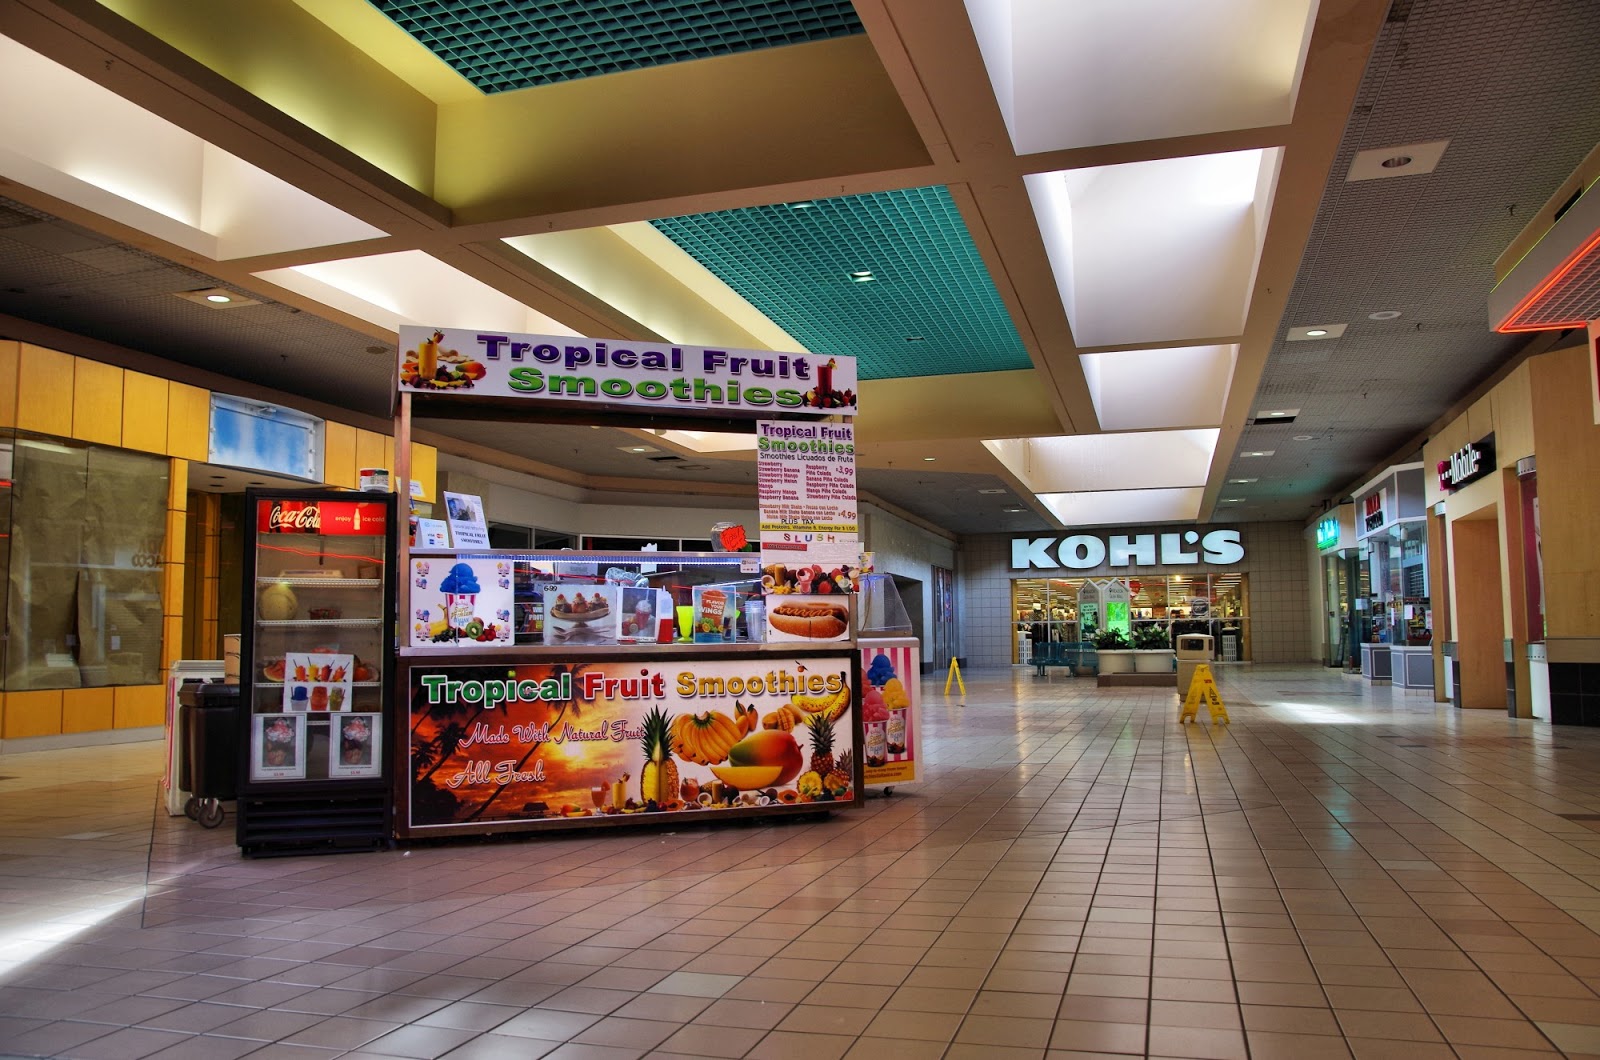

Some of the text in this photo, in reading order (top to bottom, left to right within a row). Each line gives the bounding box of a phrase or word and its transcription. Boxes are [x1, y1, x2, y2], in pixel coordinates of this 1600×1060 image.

[477, 334, 810, 380] Tropical Fruit
[507, 366, 804, 408] Smoothies
[761, 424, 852, 440] Tropical Fruit
[758, 437, 855, 455] Smoothies
[760, 452, 795, 461] Smoothies
[797, 453, 826, 462] Licuados
[838, 455, 854, 463] Fruta
[269, 505, 320, 529] Coca-Cola
[783, 533, 835, 544] SLUSH
[1011, 529, 1245, 569] KOHL'S
[699, 606, 723, 615] WINGS
[421, 667, 844, 708] Tropical Fruit Smoothies
[459, 720, 645, 748] Made With Natural Fruit
[446, 759, 546, 788] All Fresh
